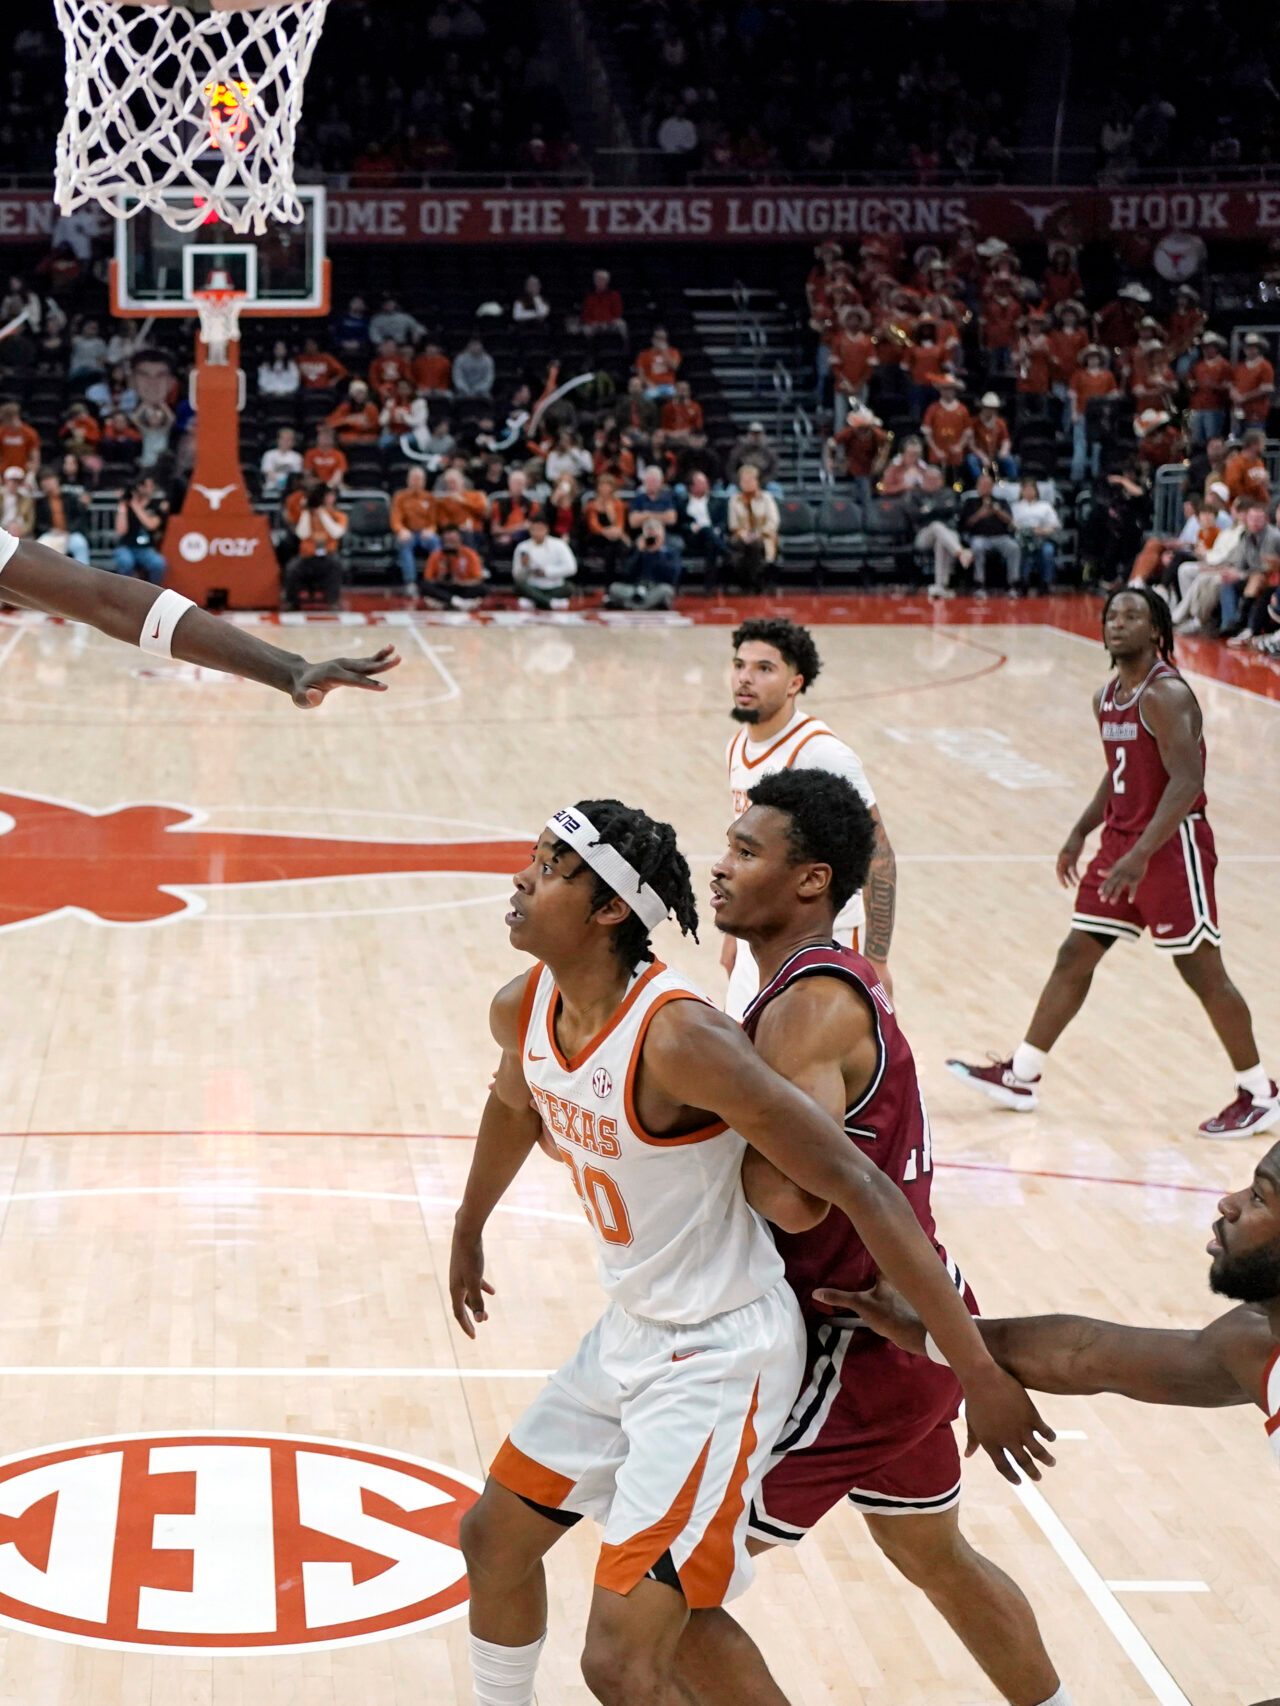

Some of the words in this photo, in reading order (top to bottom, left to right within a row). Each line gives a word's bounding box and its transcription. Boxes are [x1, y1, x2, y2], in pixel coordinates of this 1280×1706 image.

[322, 200, 407, 236] OME
[420, 200, 469, 235] OF
[484, 199, 565, 235] THE
[580, 199, 713, 234] TEXAS
[726, 199, 967, 234] LONGHORNS
[1109, 193, 1229, 231] HOOK
[1112, 746, 1126, 794] 2
[592, 1067, 613, 1098] SEC
[530, 1081, 623, 1160] TEXAS
